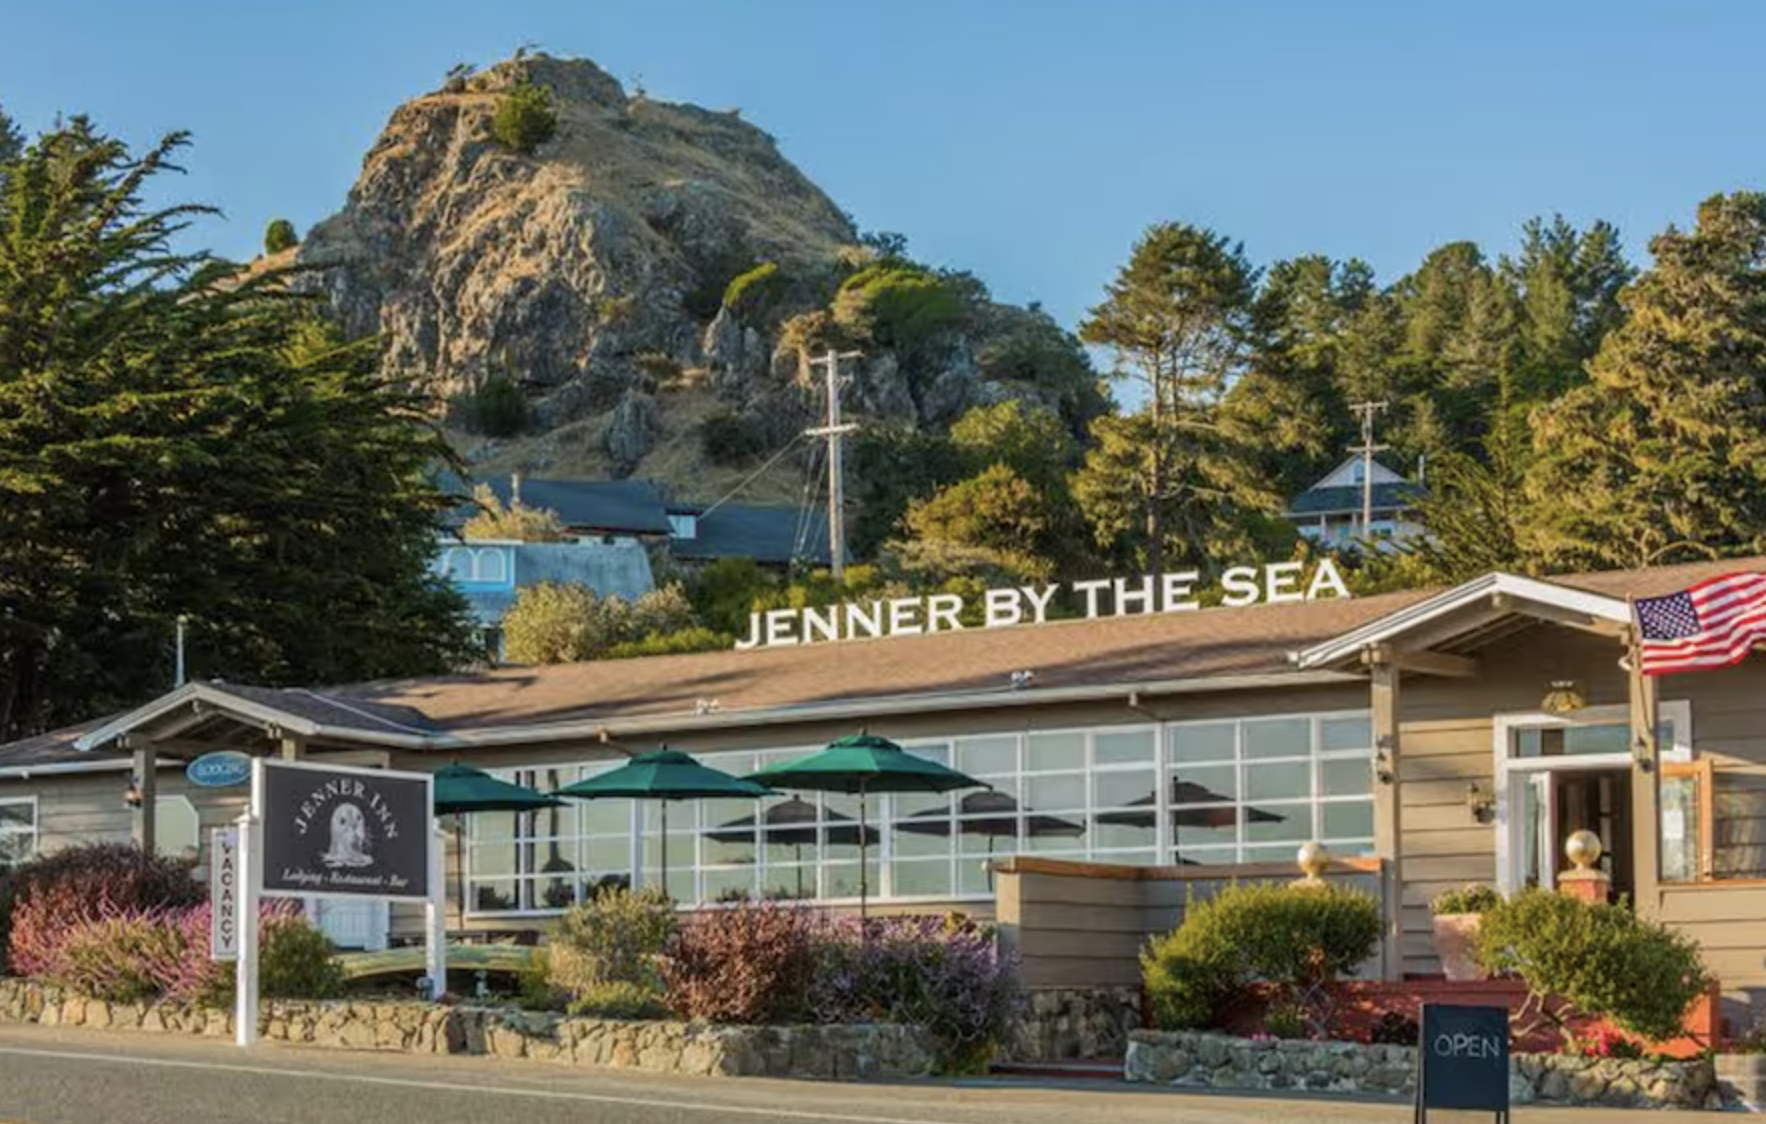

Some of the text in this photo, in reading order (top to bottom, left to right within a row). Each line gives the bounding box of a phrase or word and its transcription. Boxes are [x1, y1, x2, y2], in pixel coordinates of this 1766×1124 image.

[733, 557, 1350, 650] JENNER BY THE SEA
[295, 778, 365, 835] JENNER
[220, 841, 233, 949] VACANCY
[1433, 1032, 1501, 1058] OPEN
